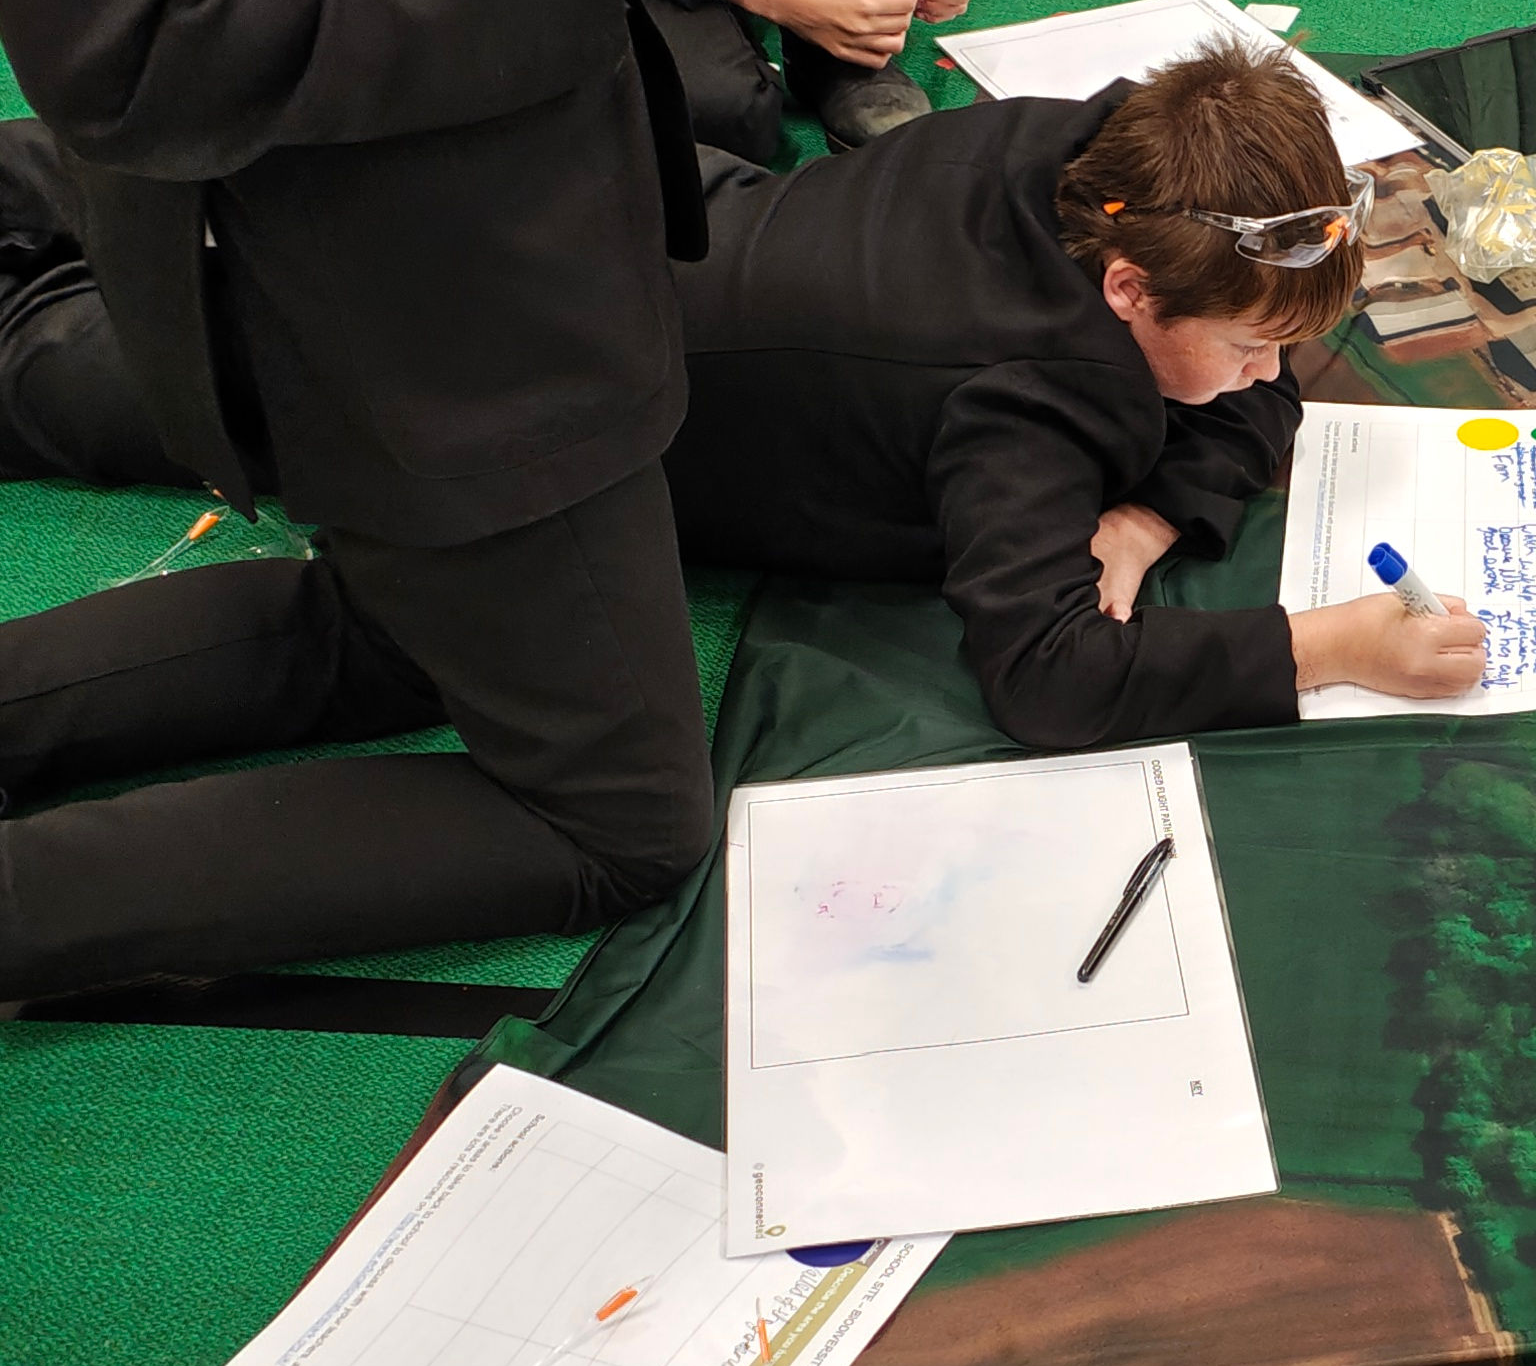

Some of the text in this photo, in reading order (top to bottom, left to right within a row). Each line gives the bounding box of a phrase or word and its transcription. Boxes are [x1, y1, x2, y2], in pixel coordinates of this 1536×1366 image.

[1151, 758, 1164, 786] CODED
[1155, 785, 1169, 812] FLIGHT
[1160, 812, 1172, 833] PATH
[488, 1105, 512, 1126] There
[494, 1105, 522, 1133] Choose
[474, 1121, 493, 1141] are
[486, 1108, 547, 1176] School actions:
[454, 1151, 469, 1166] of
[464, 1138, 480, 1157] lots
[468, 1139, 489, 1162] areas
[459, 1160, 475, 1176] to
[425, 1163, 459, 1203] resources
[443, 1169, 466, 1194] take
[413, 1198, 428, 1215] on
[427, 1187, 451, 1213] back
[752, 1172, 768, 1238] geoconnected
[421, 1210, 434, 1220] to
[400, 1218, 424, 1246] school
[390, 1246, 404, 1257] to
[879, 1238, 914, 1278] SCHOOL
[364, 1255, 395, 1289] discuss
[822, 1262, 855, 1300] Describe
[347, 1285, 370, 1310] with
[860, 1277, 885, 1305] SITE
[333, 1307, 352, 1327] your
[811, 1298, 824, 1316] the
[793, 1313, 812, 1334] area
[300, 1327, 335, 1358] teachers,
[780, 1331, 797, 1350] you
